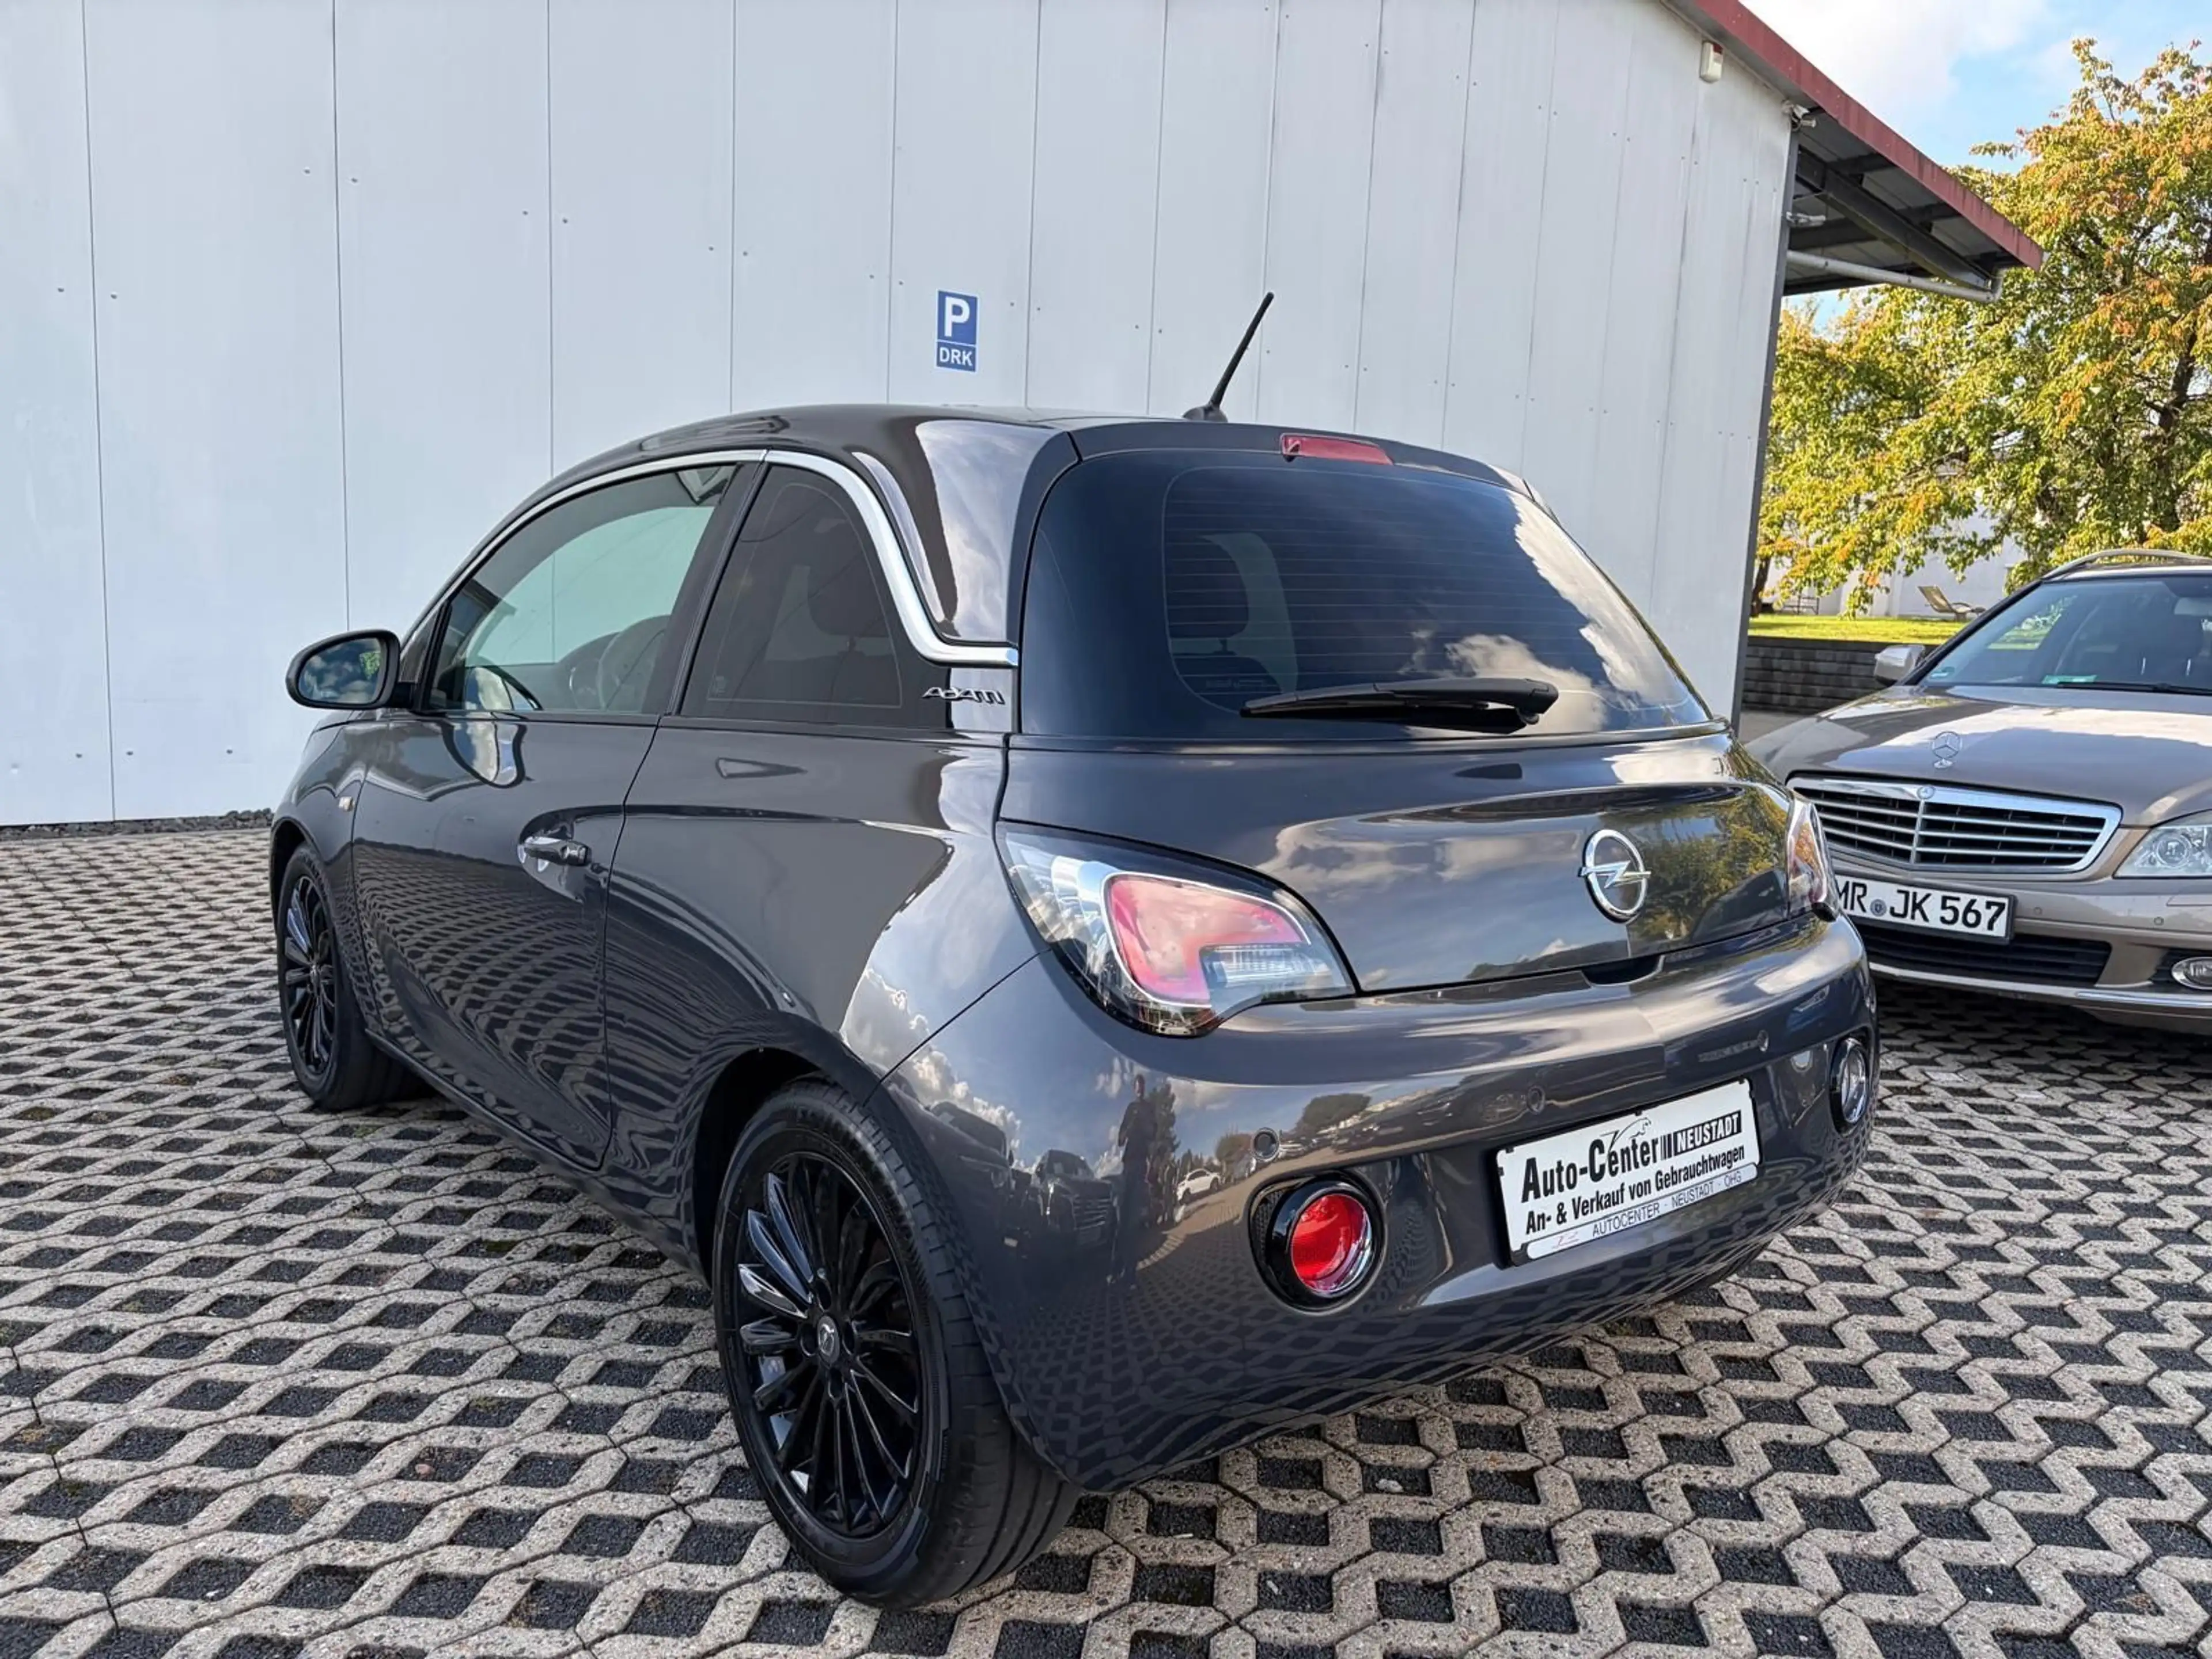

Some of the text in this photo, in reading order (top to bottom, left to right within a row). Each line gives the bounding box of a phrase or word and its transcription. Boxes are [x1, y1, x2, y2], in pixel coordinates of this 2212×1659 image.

[945, 296, 970, 337] P
[940, 347, 973, 366] DRK
[1889, 889, 1930, 922] JK
[1940, 895, 2006, 931] 567
[1521, 1113, 1738, 1203] Auto-Center NEUSTADT
[1526, 1144, 1745, 1234] An- & Verkauf von Gebrauchtwagen
[1593, 1202, 1660, 1237] AUTOCENTER
[1672, 1181, 1714, 1209] NEUSTADT
[1724, 1171, 1742, 1187] OHG
